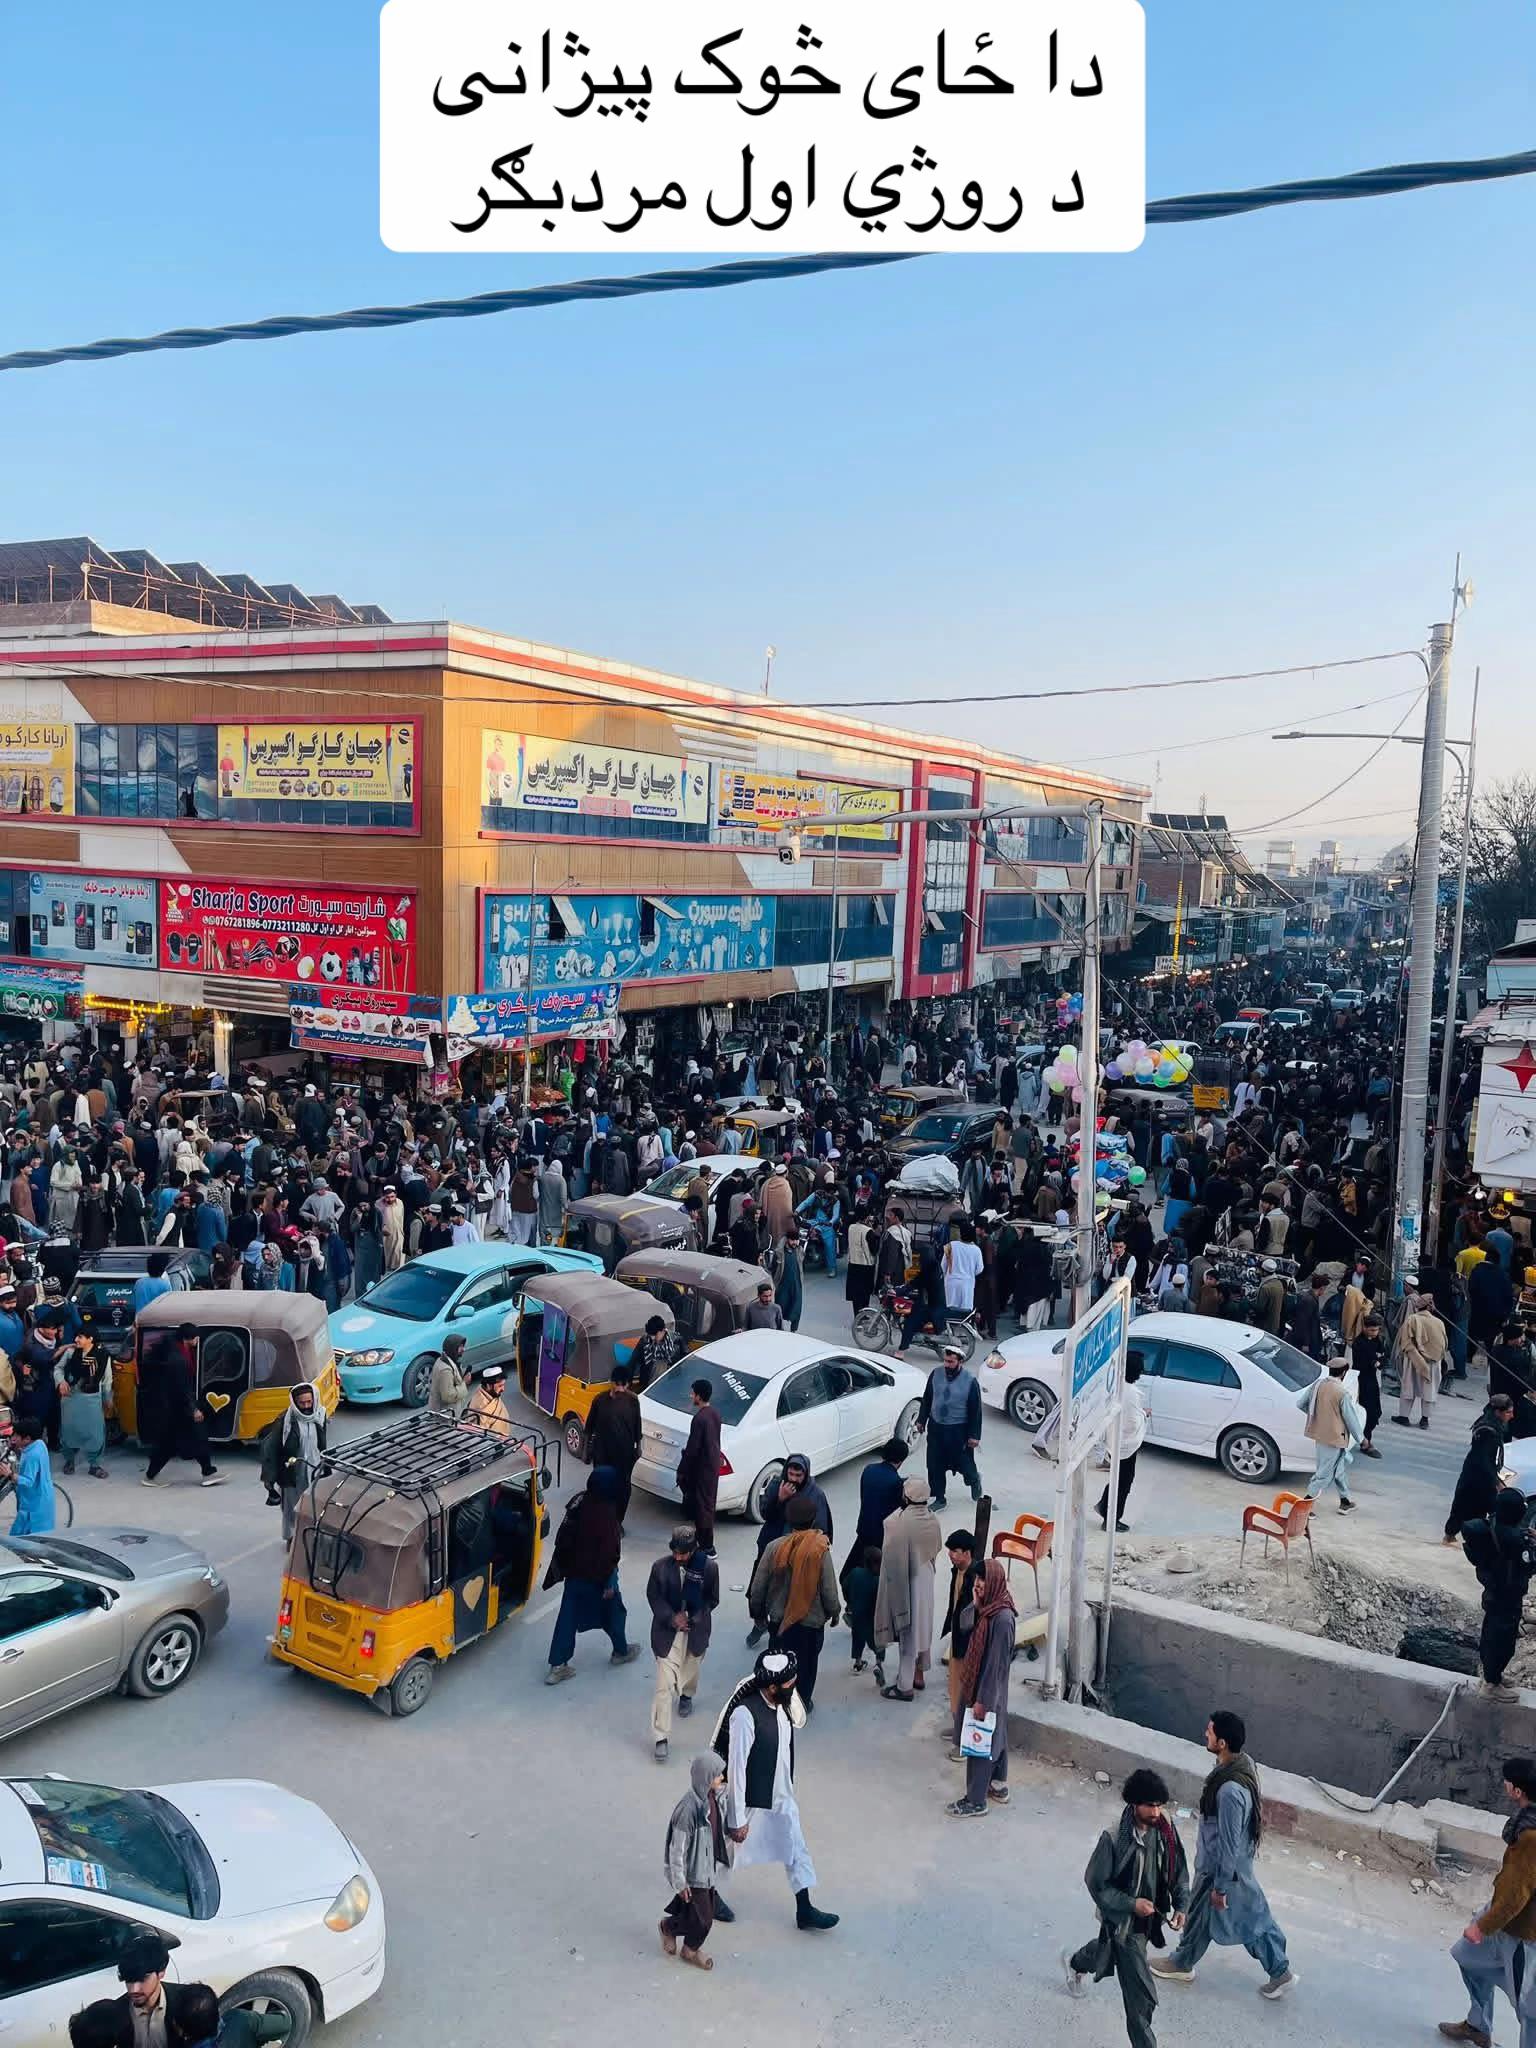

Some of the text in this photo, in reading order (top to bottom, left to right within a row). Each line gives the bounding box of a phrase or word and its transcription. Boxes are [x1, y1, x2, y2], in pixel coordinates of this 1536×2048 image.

[346, 731, 383, 766] جهان
[640, 763, 677, 801] جهان
[192, 886, 245, 916] Sharja
[249, 890, 295, 918] Sport
[298, 895, 386, 920] شارجه سپورت
